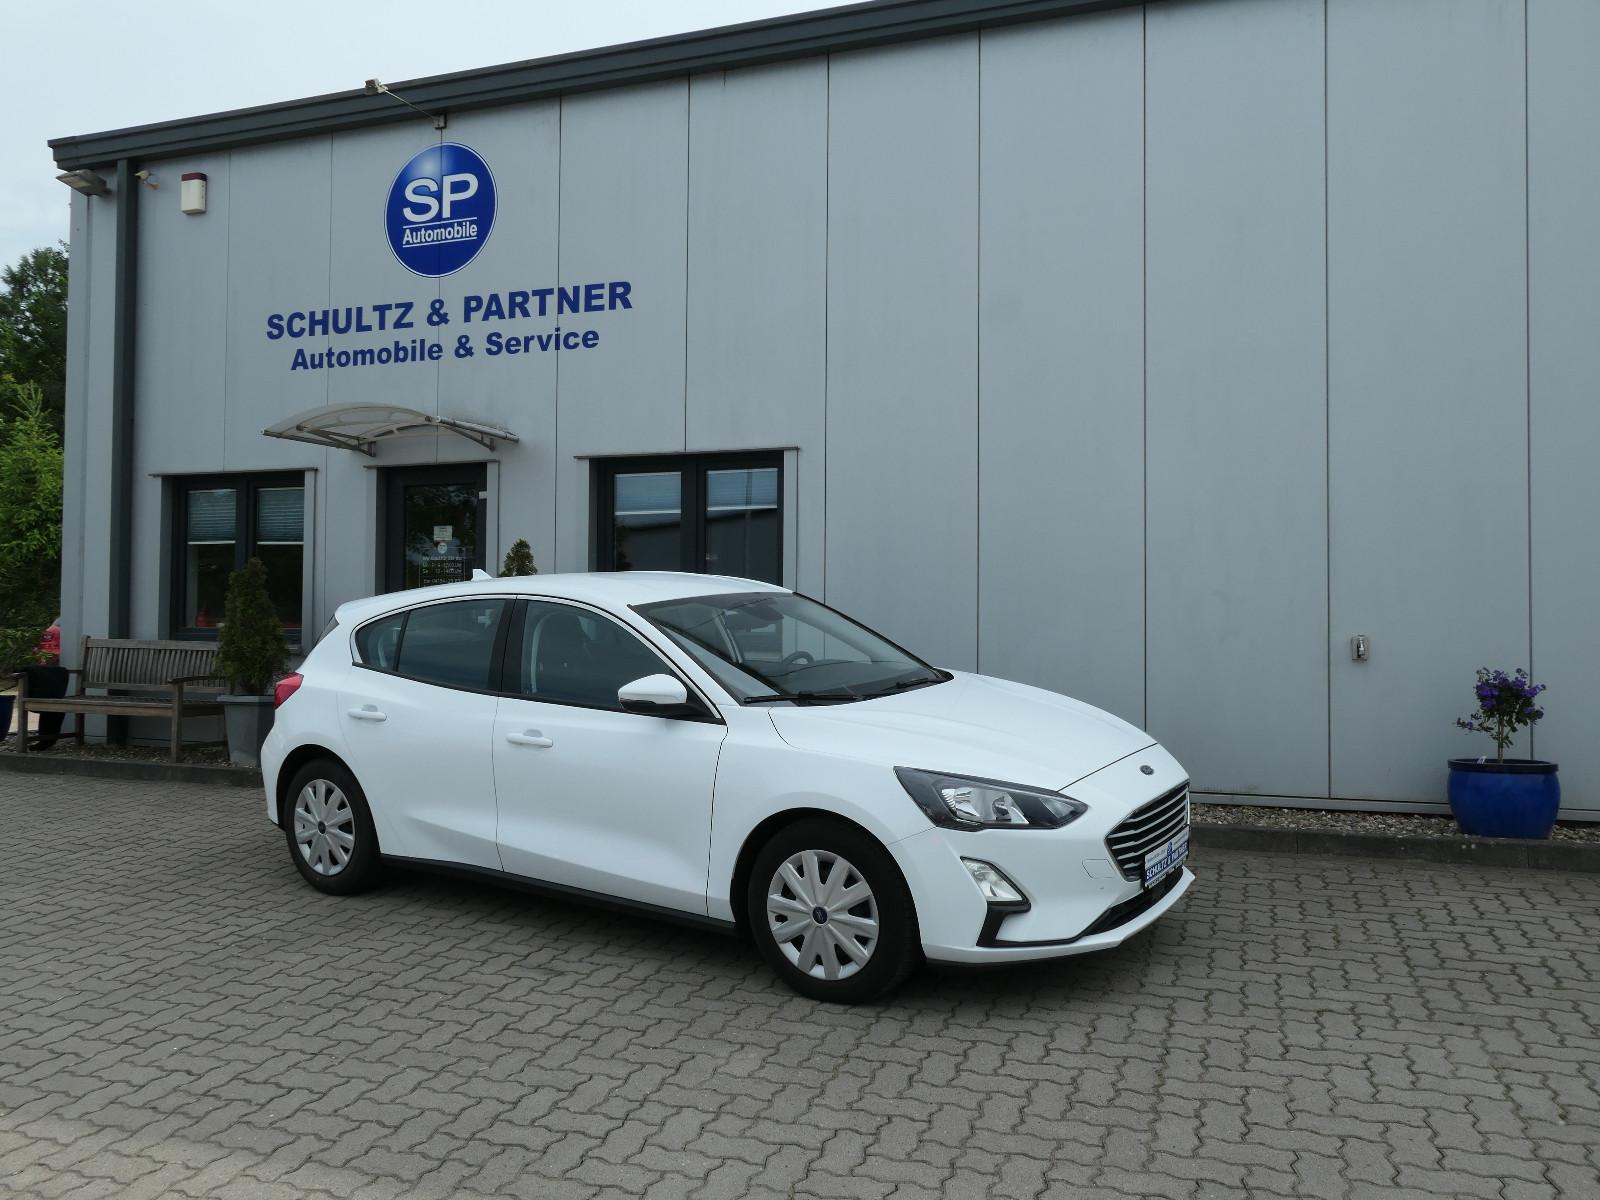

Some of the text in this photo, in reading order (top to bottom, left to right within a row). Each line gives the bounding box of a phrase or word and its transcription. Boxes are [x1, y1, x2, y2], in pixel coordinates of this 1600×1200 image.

[402, 173, 479, 222] SP
[402, 221, 477, 245] Automobile
[266, 281, 633, 340] SCHULTZ & PARTNER
[291, 327, 600, 371] Automobile & Service
